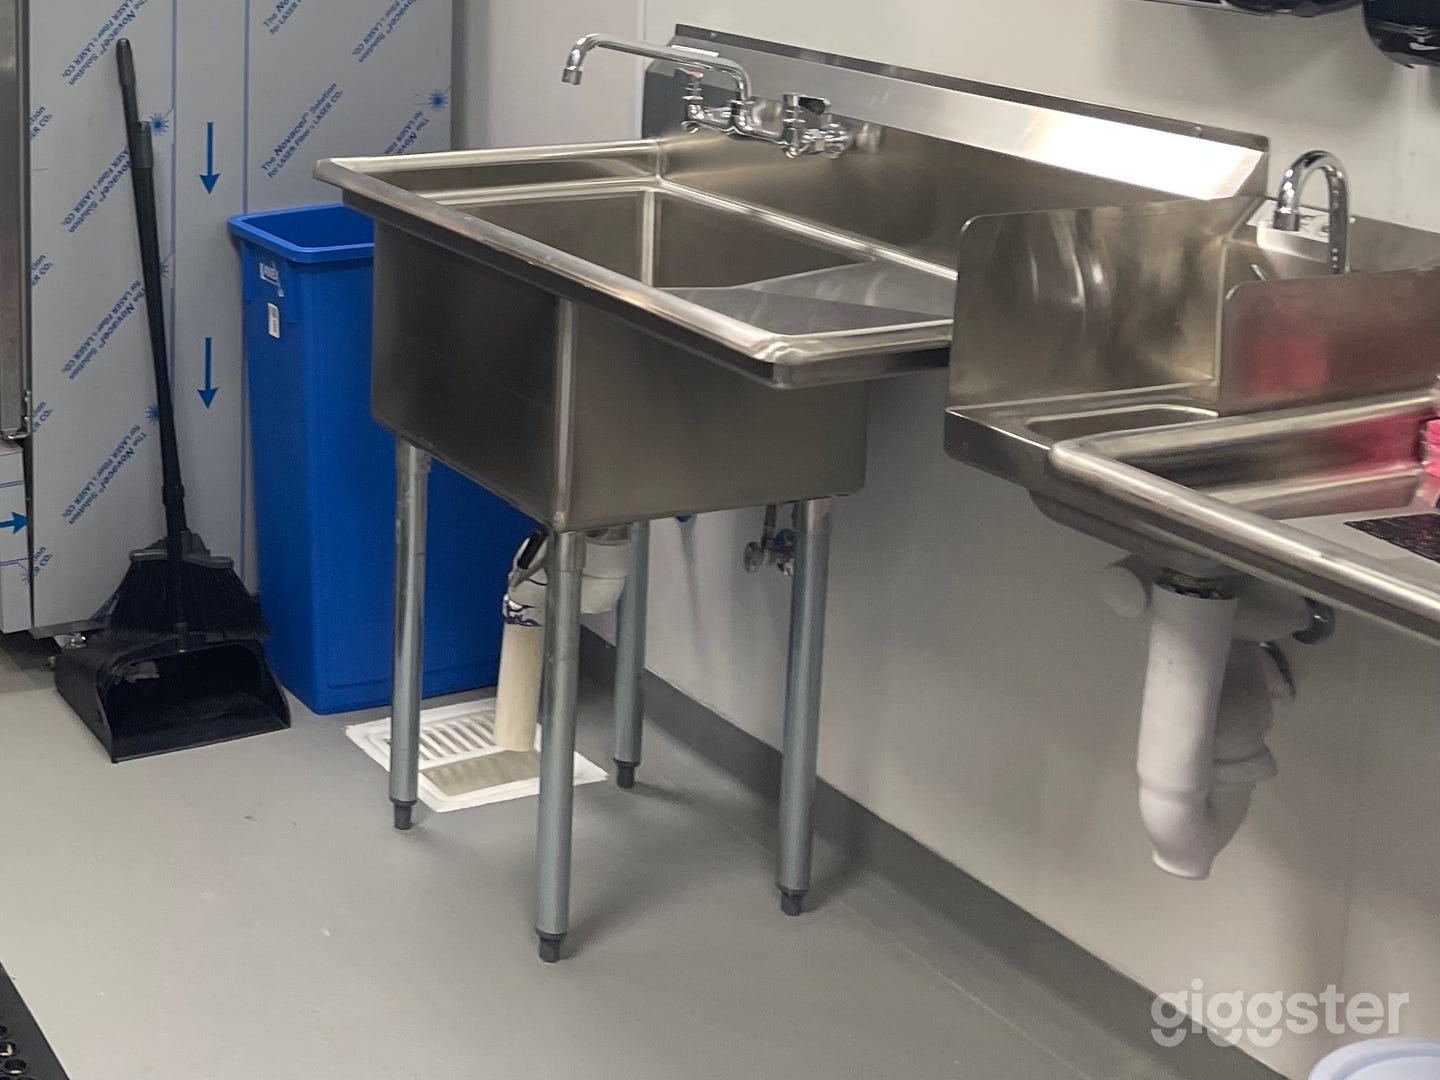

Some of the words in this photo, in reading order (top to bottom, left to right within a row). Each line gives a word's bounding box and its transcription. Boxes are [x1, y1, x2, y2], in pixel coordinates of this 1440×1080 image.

[112, 0, 134, 21] LASER
[279, 3, 299, 25] LASER
[74, 43, 96, 66] LASER
[69, 54, 99, 86] Solution
[277, 147, 297, 169] LASER
[313, 103, 333, 125] LASER
[74, 191, 95, 214] LASER
[70, 202, 99, 233] Solution
[112, 292, 133, 315] LASER
[74, 337, 95, 361] LASER
[70, 348, 98, 380] Solution
[112, 436, 132, 459] LASER
[133, 433, 148, 447] The
[75, 482, 95, 505] LASER
[69, 493, 98, 525] Solution
